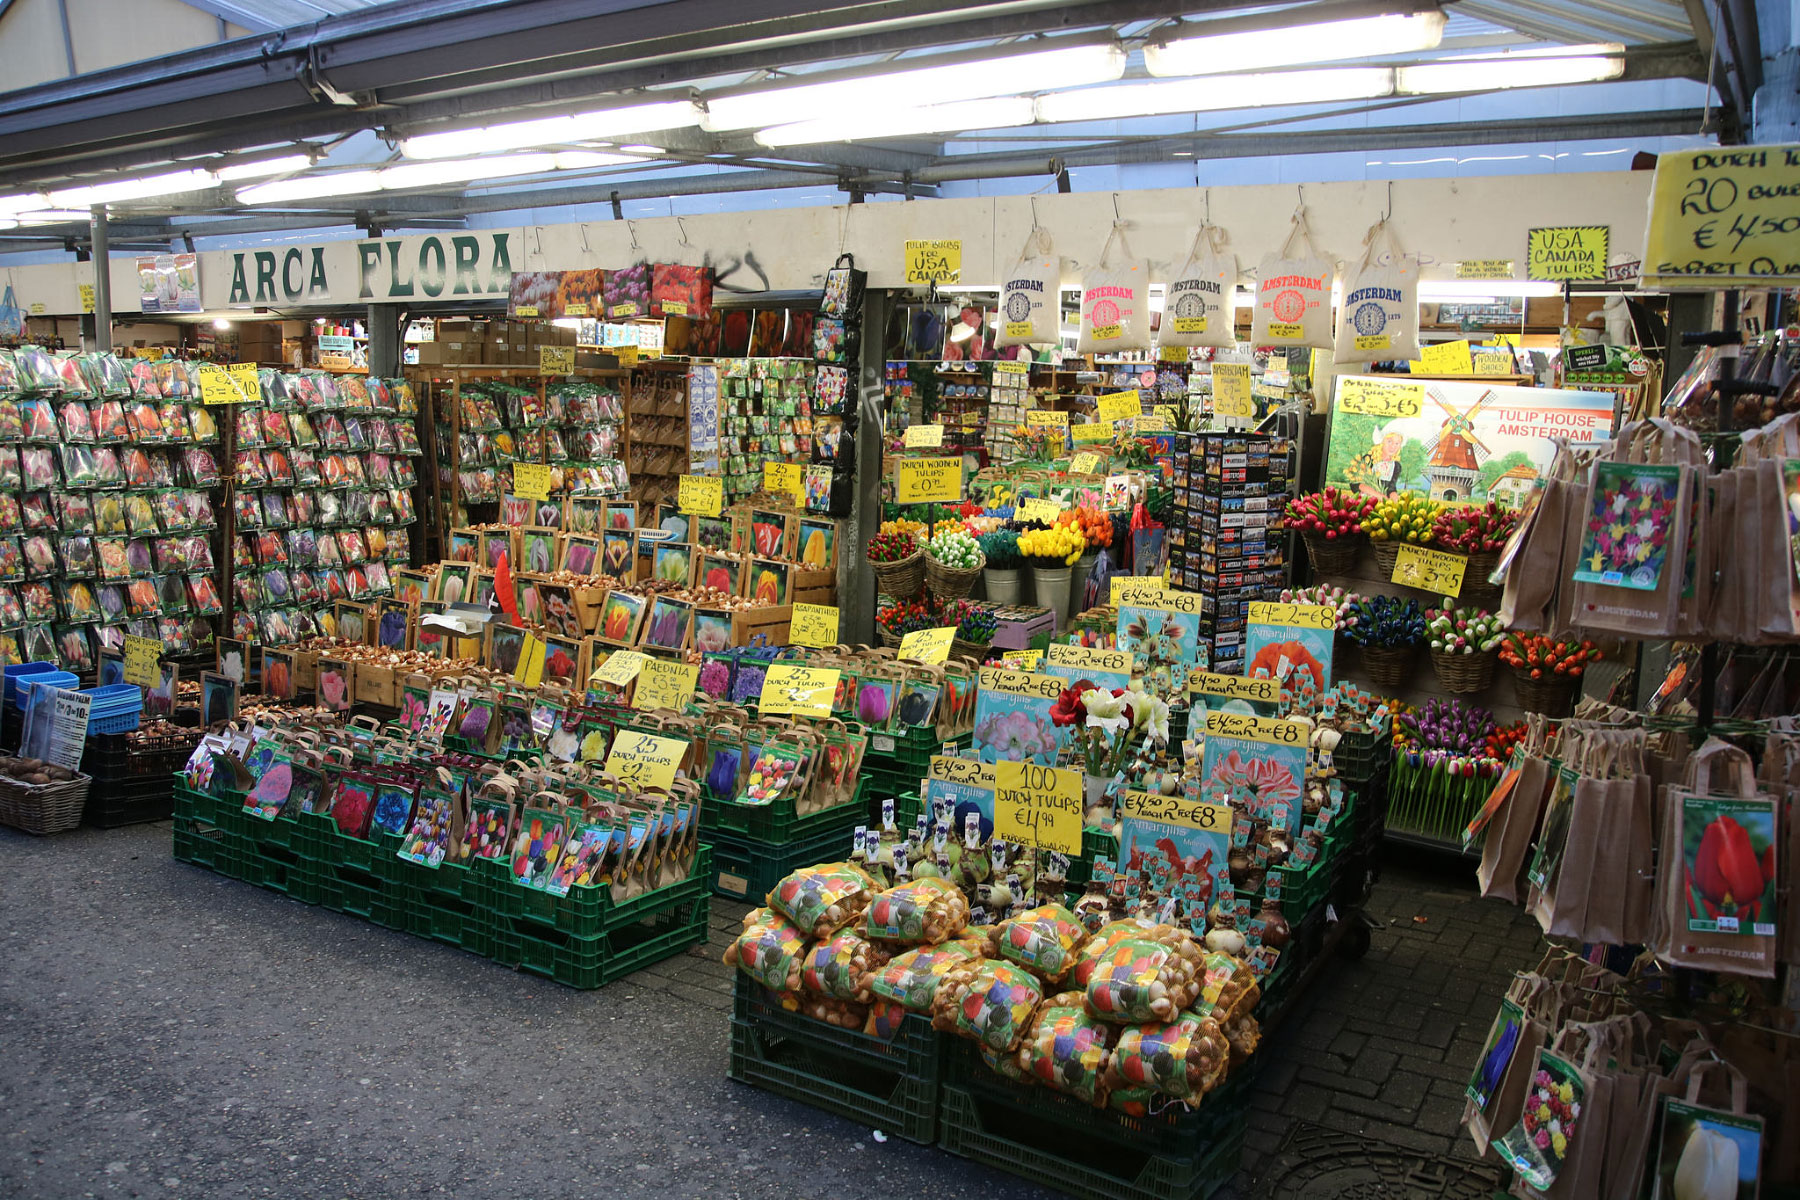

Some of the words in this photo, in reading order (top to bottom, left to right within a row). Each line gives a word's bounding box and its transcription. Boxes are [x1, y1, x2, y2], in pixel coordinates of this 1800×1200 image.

[1692, 150, 1767, 171] DUTCH
[1681, 177, 1738, 217] 20
[906, 240, 928, 251] TULIP
[1542, 230, 1584, 249] USA
[921, 250, 939, 258] FOR
[1534, 249, 1595, 265] CANADA
[229, 247, 329, 304] ARCA
[358, 233, 512, 298] FLORA
[914, 257, 949, 270] USA
[1546, 263, 1595, 275] TULIPS
[1657, 260, 1742, 275] EXPORT
[907, 270, 959, 284] CANADA
[1261, 275, 1323, 293] AMSTERDAM
[228, 362, 256, 372] ULIPS
[1477, 354, 1509, 363] WOODEN
[1498, 409, 1539, 423] TULIP
[1544, 412, 1597, 428] HOUSE
[1497, 423, 1593, 442] AMSTERDAM
[775, 463, 788, 474] 25
[902, 461, 924, 470] DUTCH
[927, 459, 960, 469] WOODEN
[1154, 591, 1164, 607] 2
[1287, 605, 1300, 624] 2
[1597, 605, 1659, 619] AMSTERDAM
[811, 628, 836, 643] €10
[1250, 626, 1300, 643] Amaryllis
[785, 667, 811, 680] 25
[1019, 675, 1031, 693] 2
[1226, 677, 1238, 695] 2
[637, 686, 648, 701] 3
[982, 689, 1031, 706] Amaryllis
[1243, 717, 1258, 738] 2
[632, 735, 658, 754] 25
[1209, 736, 1267, 754] Amaryllis
[613, 750, 637, 760] DUTCH
[641, 755, 672, 766] TULIPS
[968, 763, 982, 784] 2
[1020, 763, 1057, 792] 100
[934, 780, 985, 799] Amaryllis
[997, 787, 1032, 807] DUTCH
[1036, 793, 1080, 815] TULIPS
[1164, 800, 1179, 820] 2
[1127, 818, 1188, 839] Amaryllis
[1697, 946, 1766, 960] AMSTERDAM
